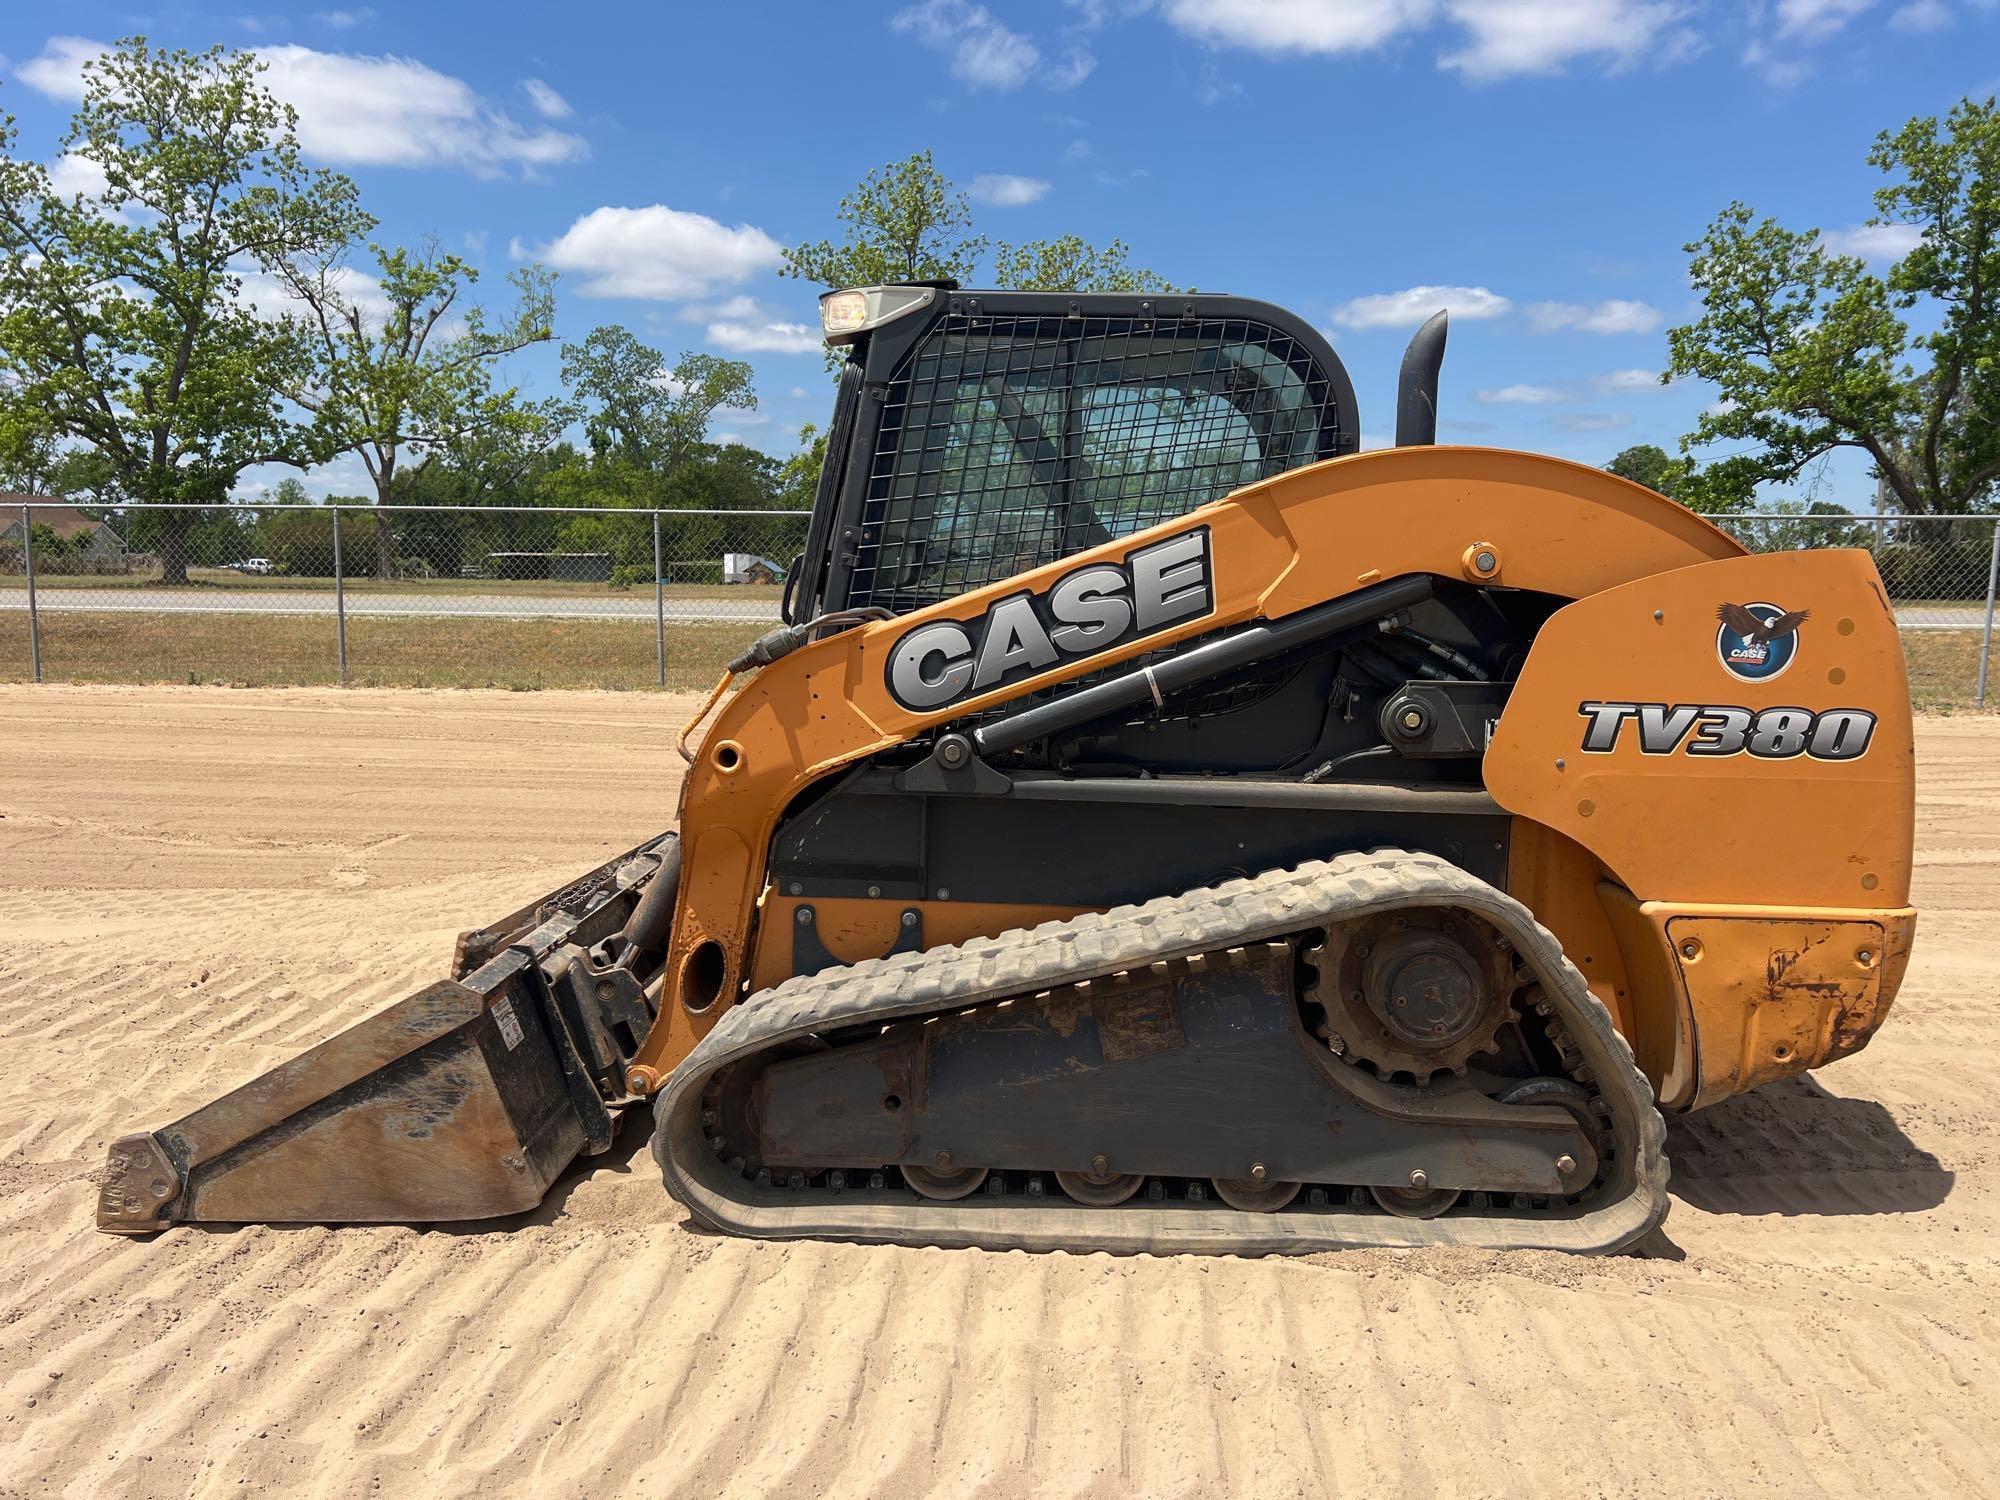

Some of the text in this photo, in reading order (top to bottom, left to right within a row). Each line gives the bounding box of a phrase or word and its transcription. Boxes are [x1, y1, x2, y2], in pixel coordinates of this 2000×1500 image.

[890, 532, 1209, 708] CASE
[1731, 648, 1767, 659] CASE
[1581, 702, 1876, 760] TV380
